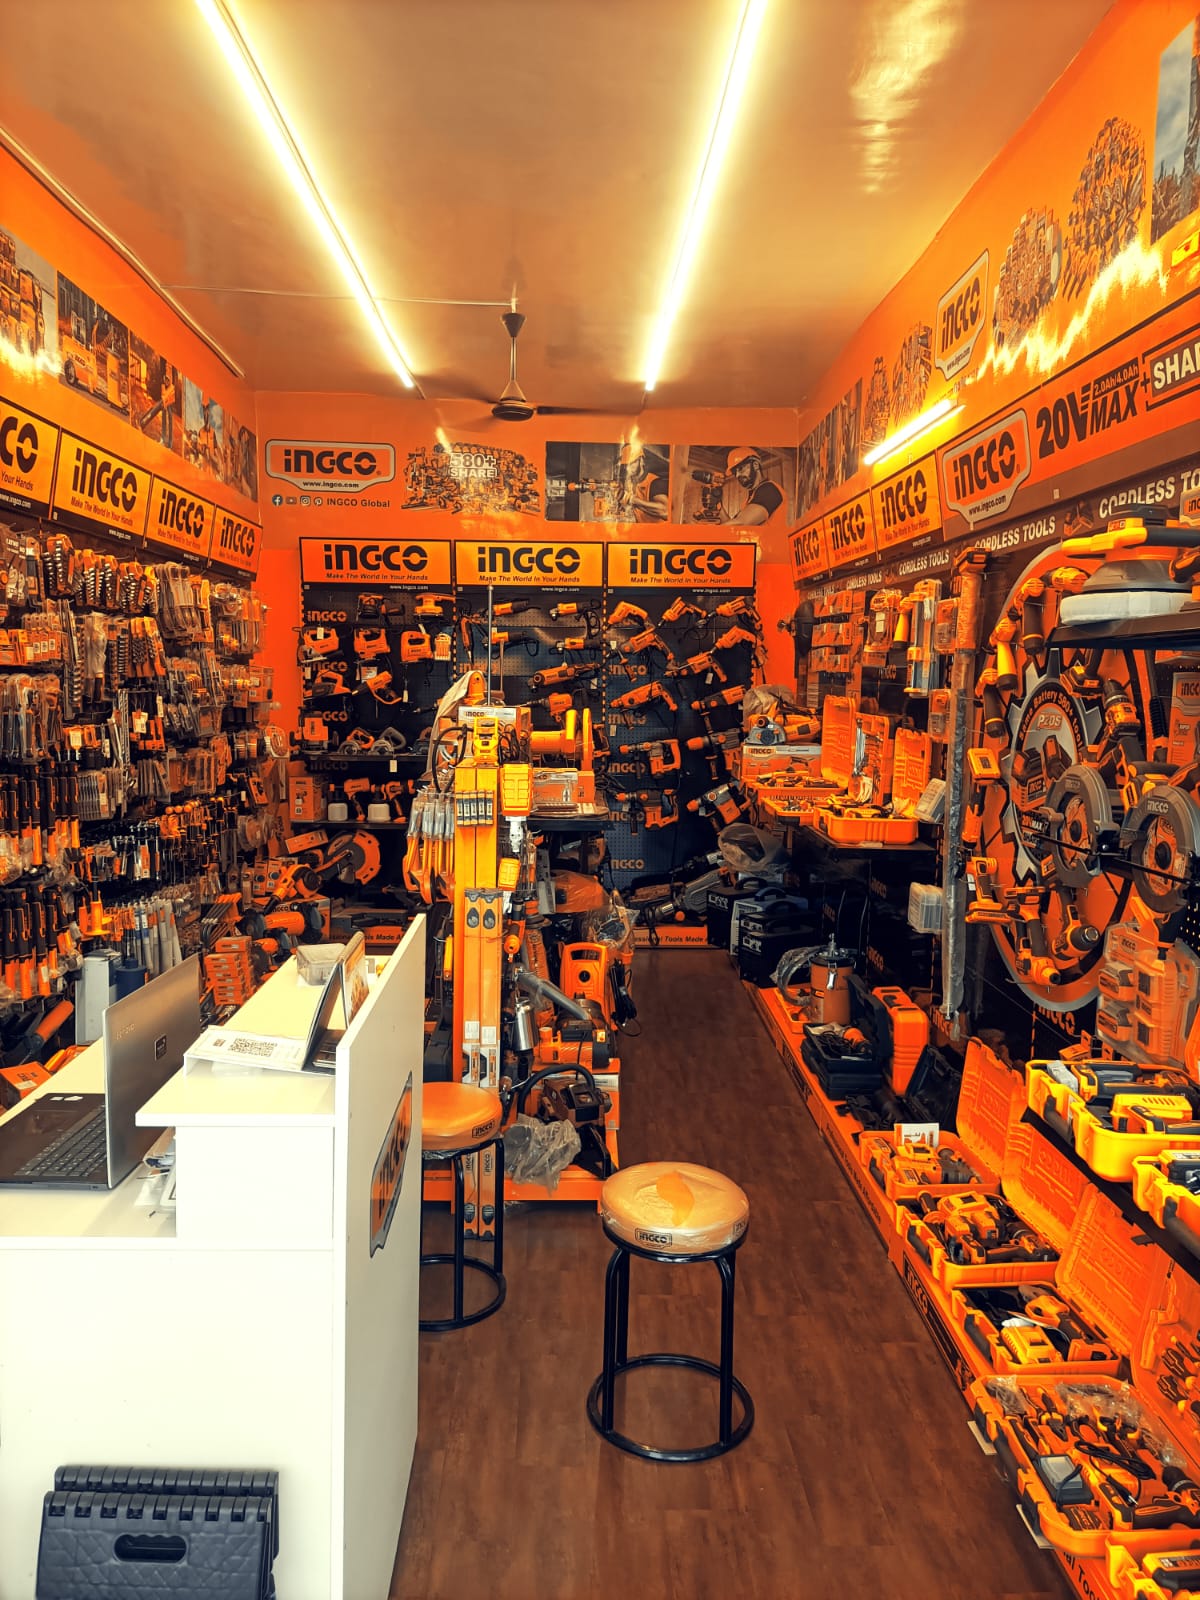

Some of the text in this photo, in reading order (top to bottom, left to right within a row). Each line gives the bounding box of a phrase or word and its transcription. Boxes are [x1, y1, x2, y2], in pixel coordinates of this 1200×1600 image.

[1094, 363, 1139, 396] 2.0Ah/4.0Ah
[1090, 380, 1140, 435] MAX
[450, 452, 497, 468] 580+
[302, 481, 359, 489] www.ingco.com
[327, 497, 390, 508] INGCO Global
[969, 495, 1006, 515] www.ingco.com
[1022, 515, 1056, 543] TOOLS
[898, 548, 950, 576] CORDLESS TOOLS
